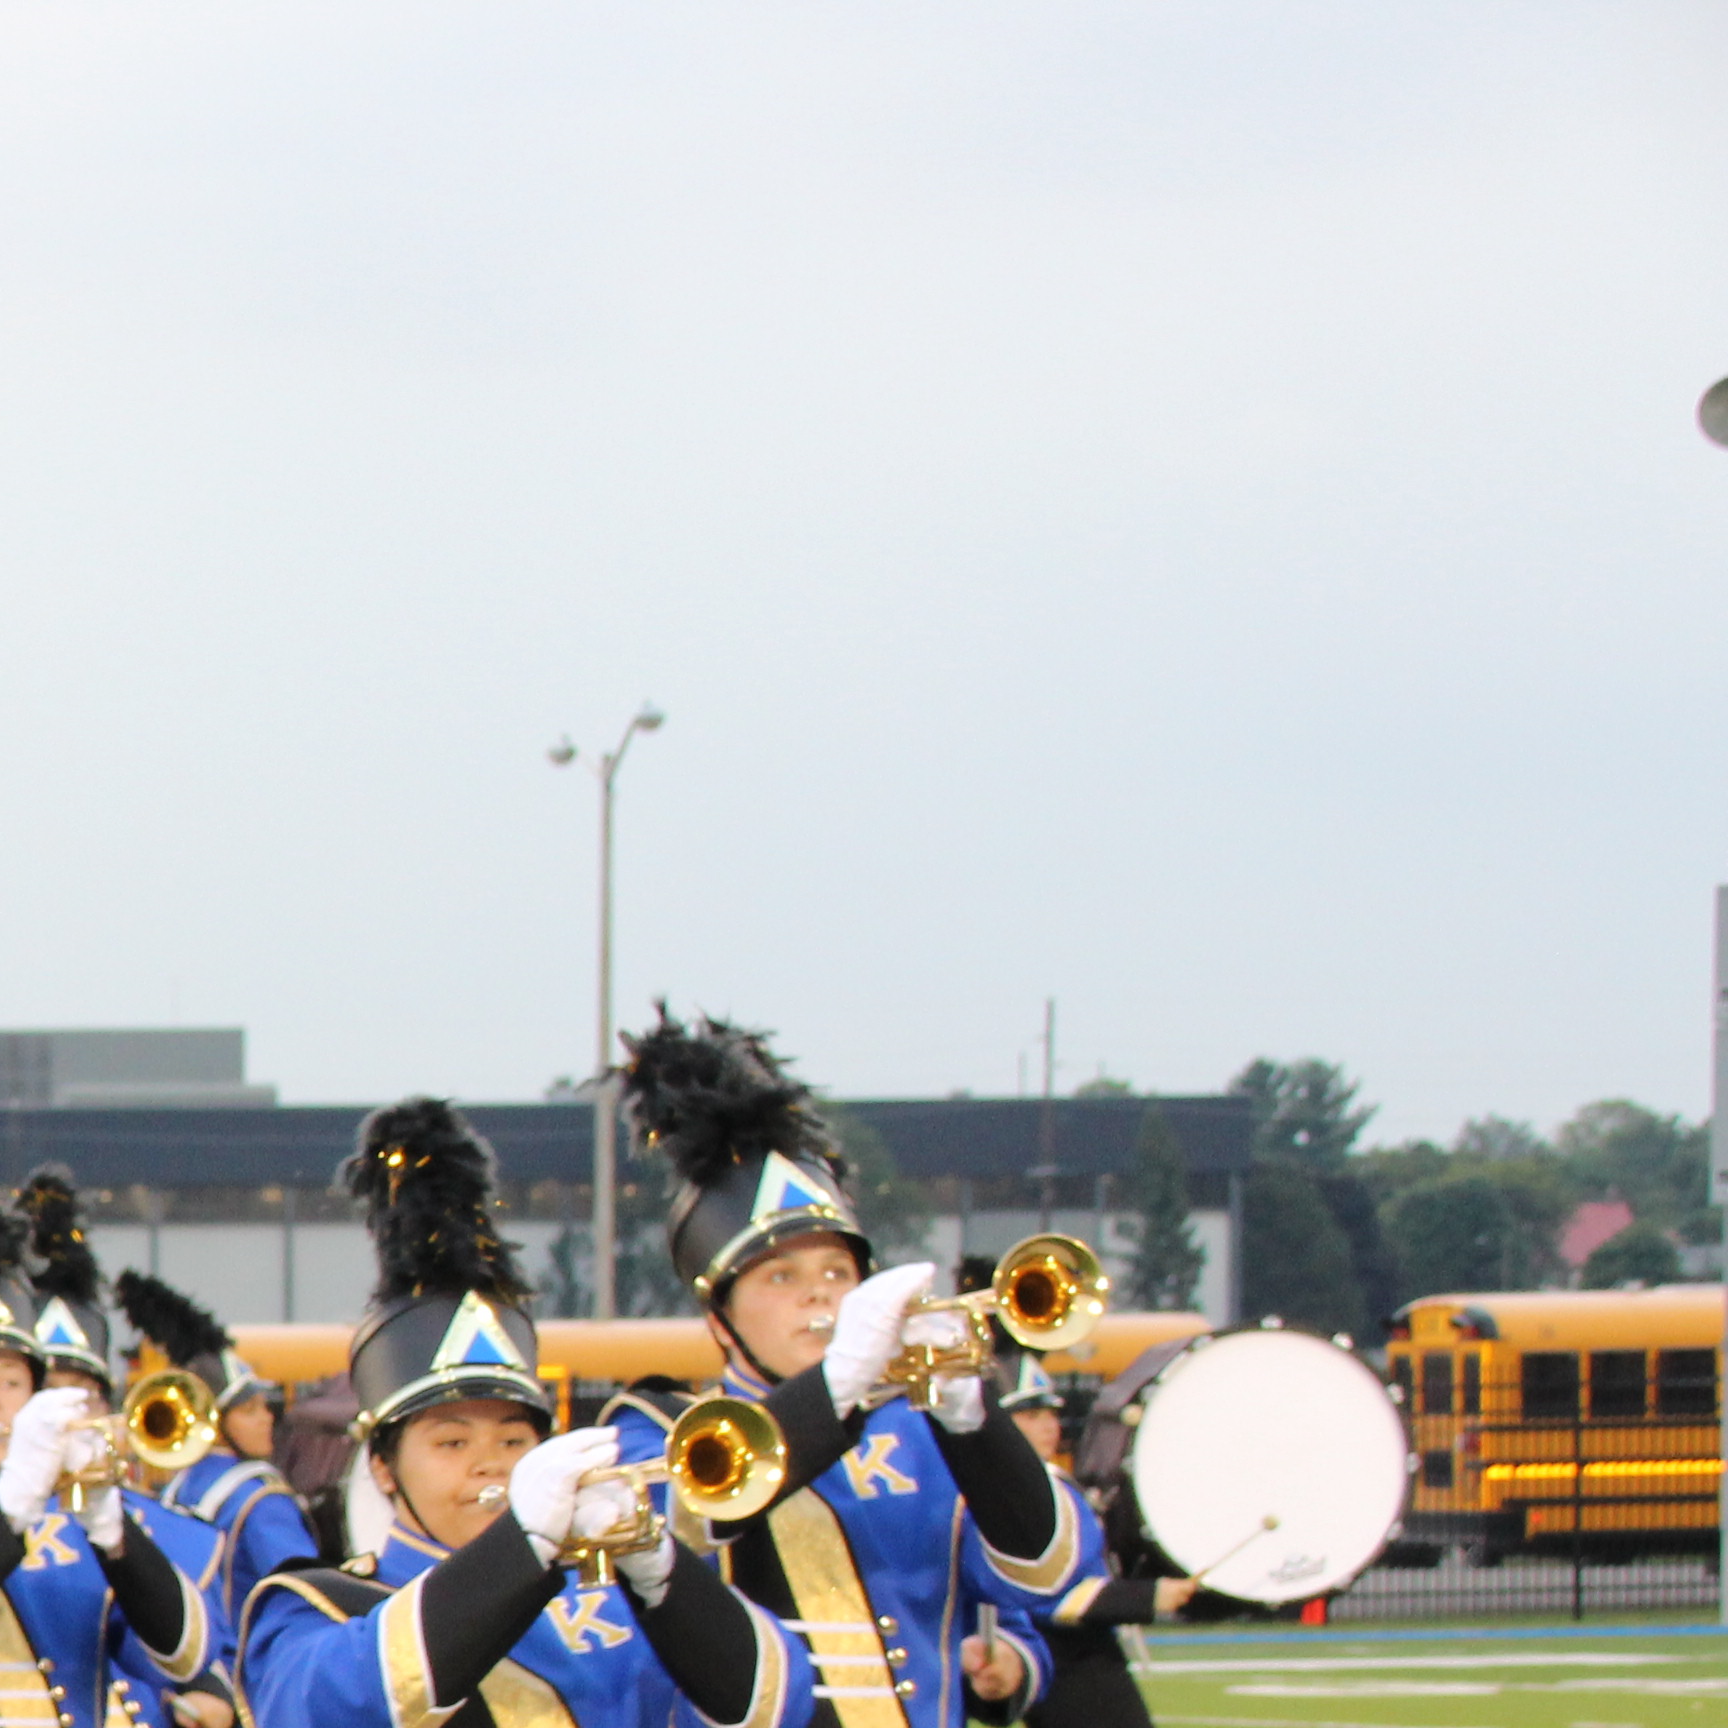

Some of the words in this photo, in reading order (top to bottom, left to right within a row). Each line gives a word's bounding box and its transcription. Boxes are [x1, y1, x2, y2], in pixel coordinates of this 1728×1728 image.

[840, 1433, 920, 1500] K
[19, 1513, 81, 1571] K
[544, 1589, 634, 1654] K
